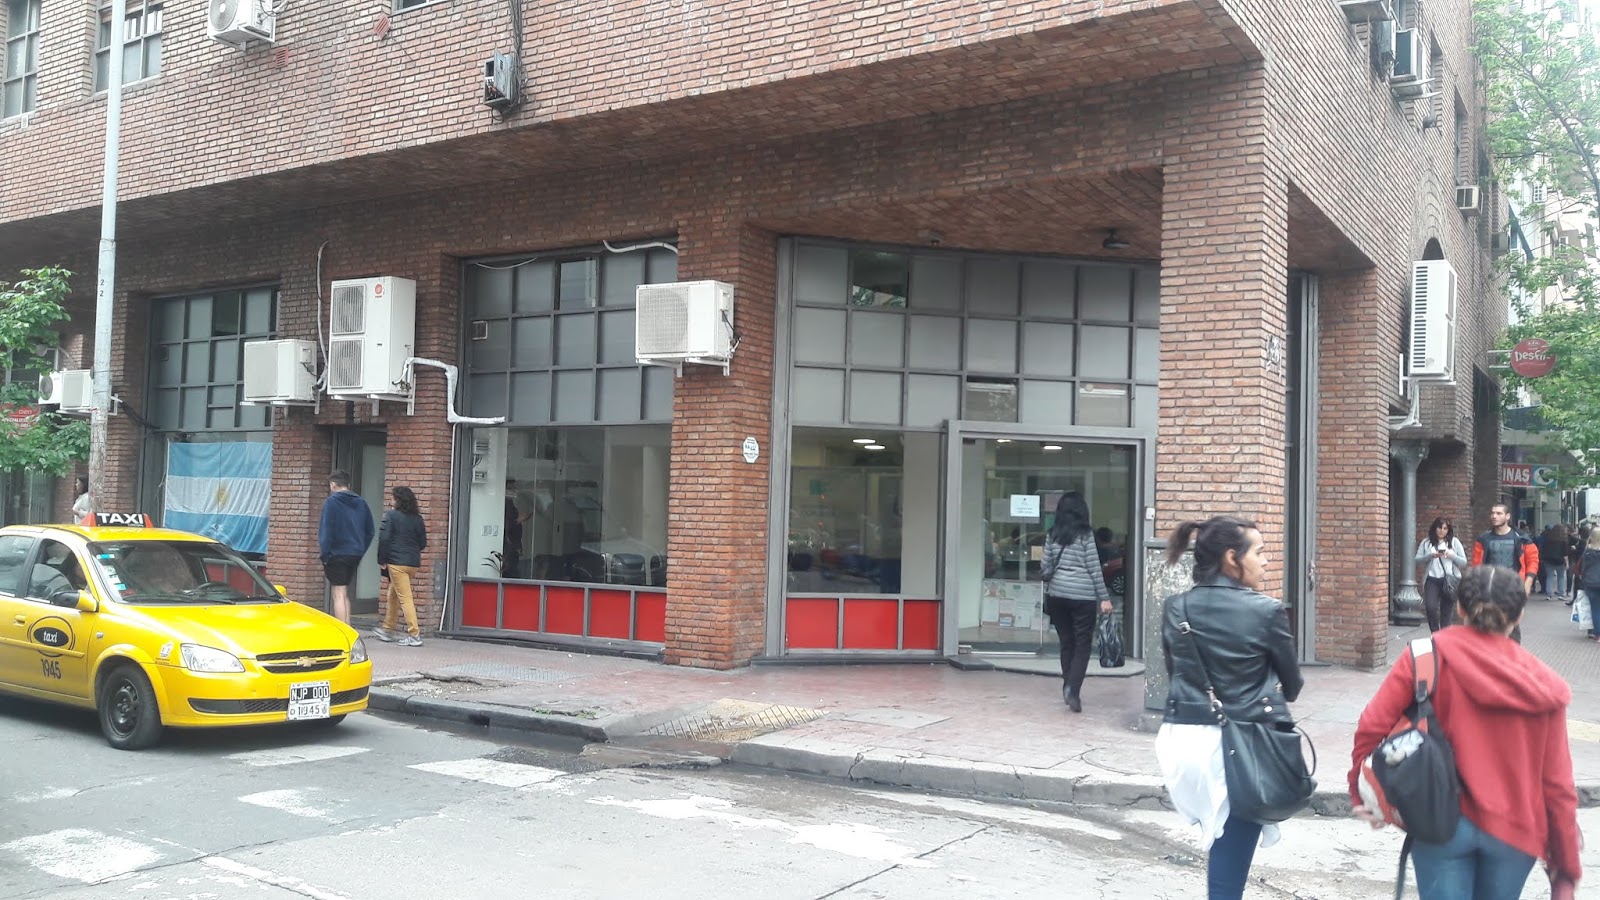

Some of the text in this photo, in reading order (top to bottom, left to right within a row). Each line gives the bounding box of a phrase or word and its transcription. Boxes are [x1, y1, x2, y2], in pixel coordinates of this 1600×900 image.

[96, 512, 144, 525] TAXI
[43, 630, 58, 643] taxi
[40, 658, 62, 680] 1945
[291, 687, 308, 701] NJP
